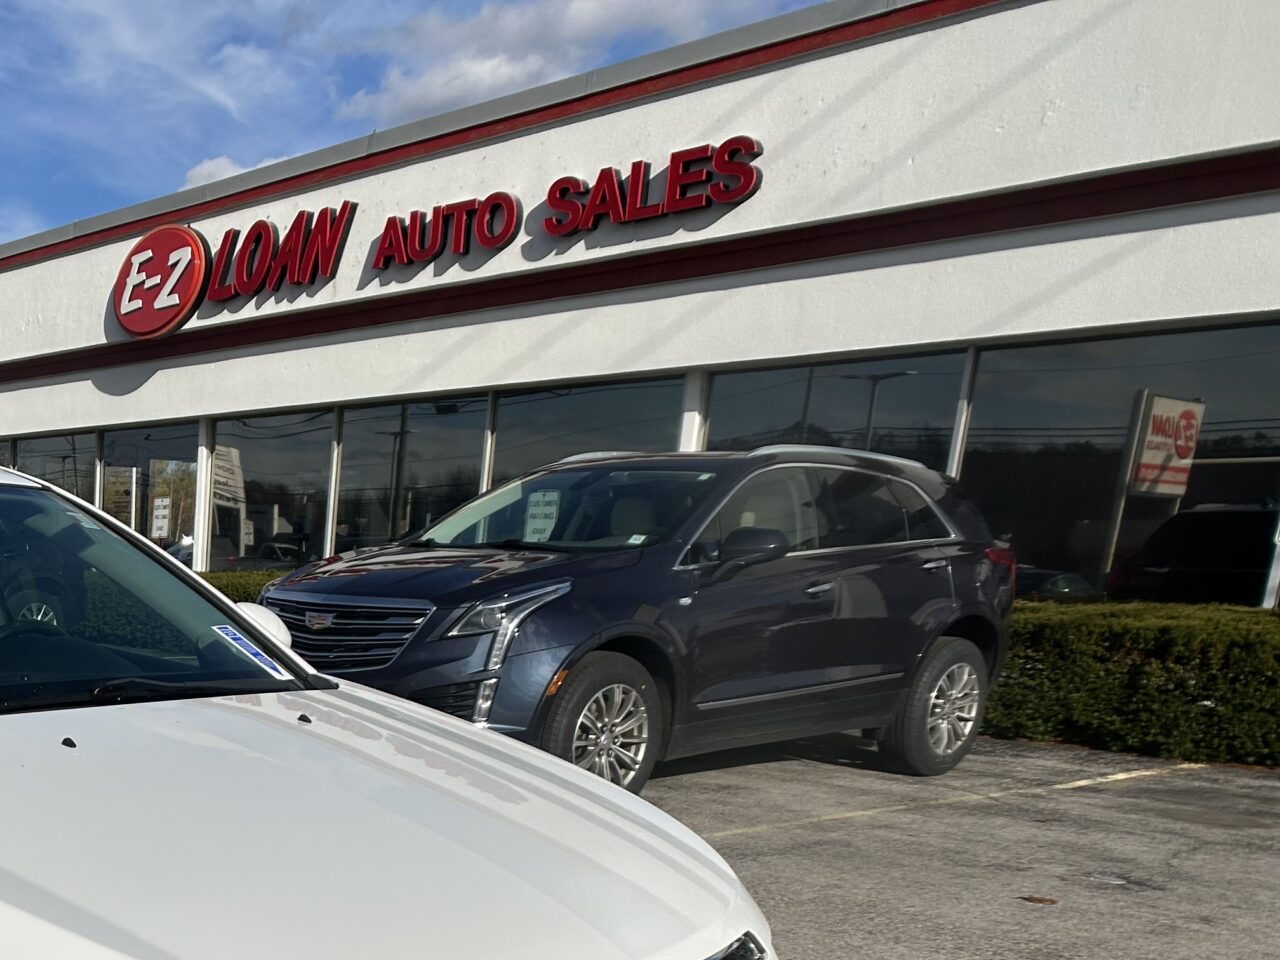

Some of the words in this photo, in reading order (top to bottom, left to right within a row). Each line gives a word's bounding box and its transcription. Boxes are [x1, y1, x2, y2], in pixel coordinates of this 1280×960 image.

[122, 246, 196, 314] E-Z
[207, 200, 358, 302] LOAN
[372, 191, 524, 271] AUTO
[542, 135, 764, 238] SALES
[530, 512, 555, 520] PARKING
